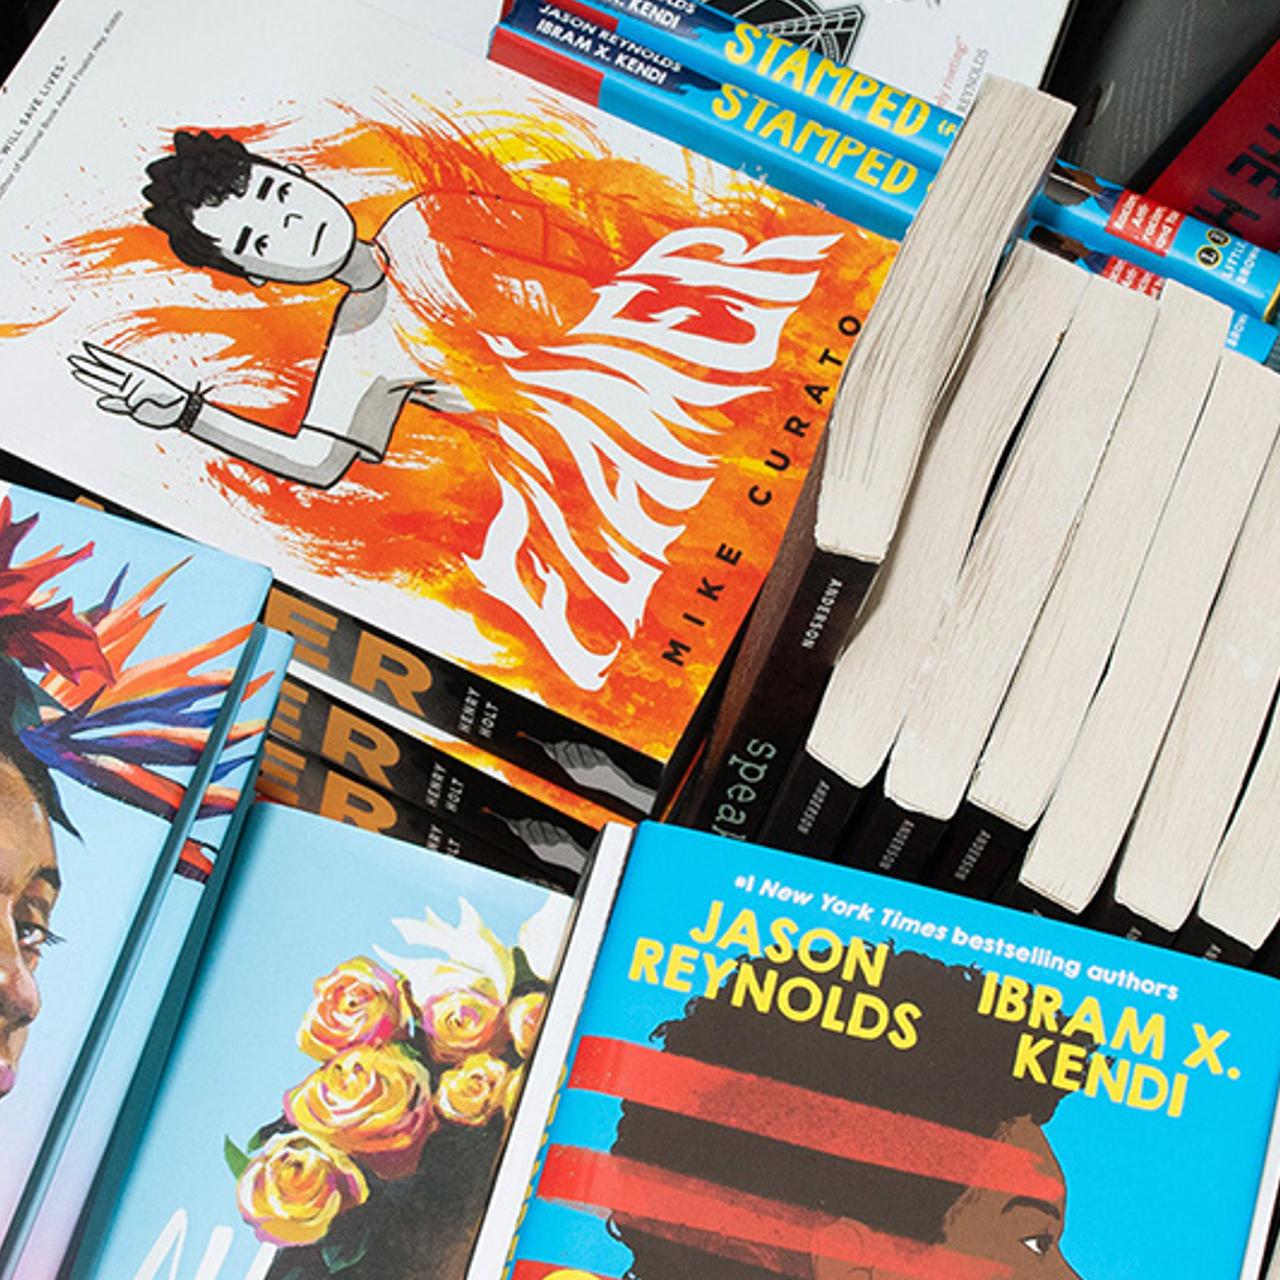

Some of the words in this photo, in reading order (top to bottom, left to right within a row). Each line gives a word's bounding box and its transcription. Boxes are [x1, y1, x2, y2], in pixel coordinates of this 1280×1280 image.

[536, 20, 592, 57] IBRAM
[595, 43, 612, 61] X.
[616, 53, 667, 85] KENDI
[539, 4, 595, 34] JASON
[602, 32, 683, 73] REYNOLDS
[725, 23, 929, 135] STAMPED
[1, 127, 21, 155] WILL
[20, 98, 40, 125] SAVE
[712, 84, 918, 195] STAMPED
[462, 227, 844, 691] FLAMER
[662, 544, 743, 666] MIKE
[748, 314, 862, 507] CURATO
[802, 577, 842, 649] ANDERSON
[458, 686, 480, 733] HENRY
[479, 700, 498, 738] HOLT
[424, 762, 447, 808] HENRY
[445, 777, 466, 814] HOLT
[690, 900, 890, 988] JASON
[758, 878, 814, 905] New
[820, 893, 874, 923] York
[881, 908, 947, 941] Times
[952, 927, 1081, 984] bestselling
[1086, 961, 1180, 1002] authors
[629, 938, 922, 1050] REYNOLDS
[978, 972, 1164, 1061] IBRAM
[1184, 1022, 1241, 1079] X.
[1013, 1034, 1188, 1118] KENDI
